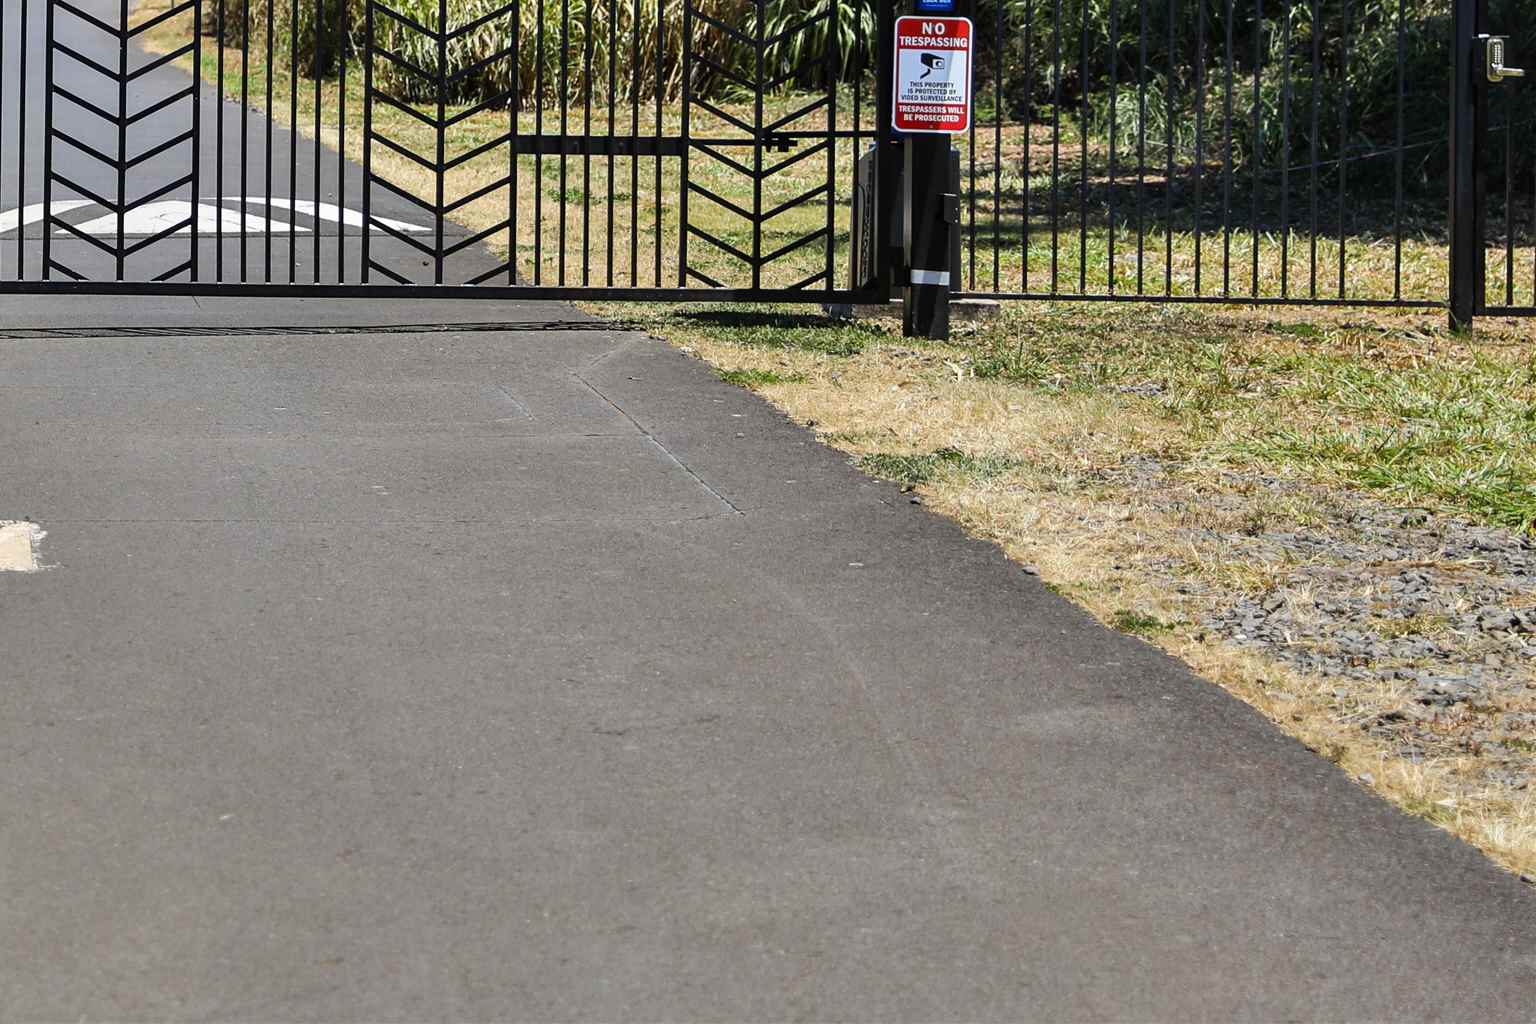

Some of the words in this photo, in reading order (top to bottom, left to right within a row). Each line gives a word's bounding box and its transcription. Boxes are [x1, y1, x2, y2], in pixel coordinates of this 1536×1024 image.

[922, 22, 945, 35] NO
[899, 36, 968, 48] TRESPASSING
[899, 105, 946, 114] TRESPASSERS
[947, 106, 965, 114] WILL
